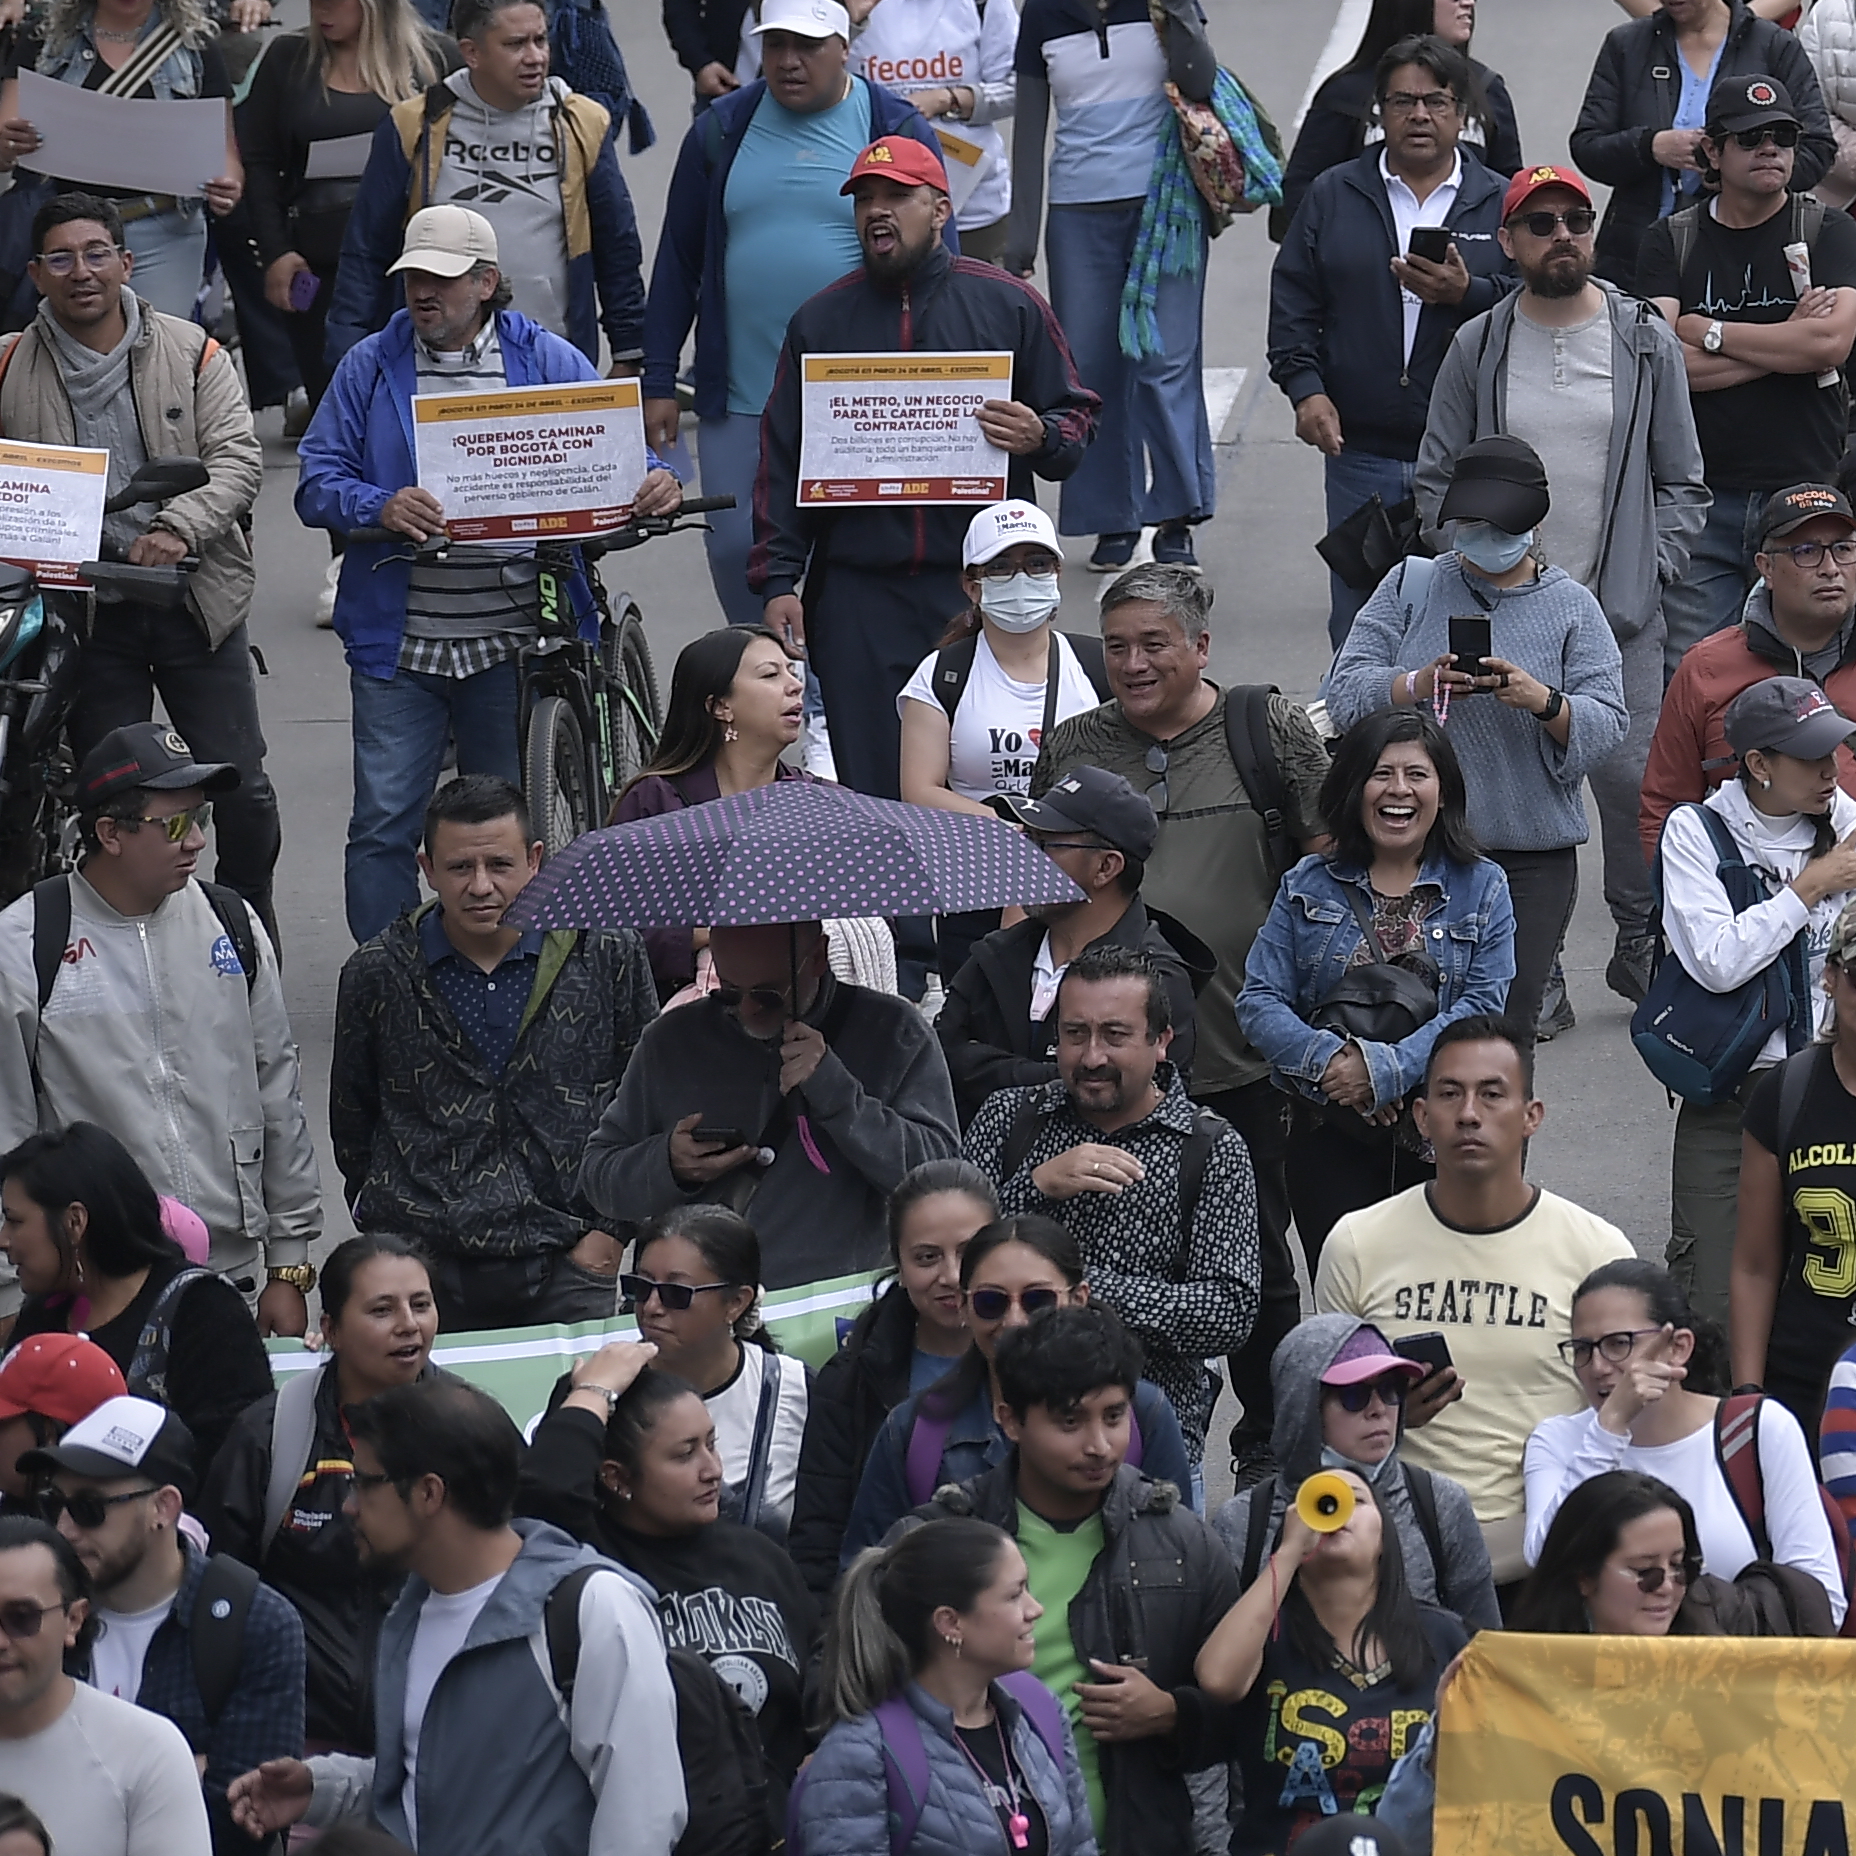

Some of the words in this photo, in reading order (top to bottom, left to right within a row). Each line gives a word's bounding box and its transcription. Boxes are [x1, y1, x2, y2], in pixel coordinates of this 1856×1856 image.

[868, 50, 963, 82] fecode
[444, 140, 556, 163] Reebo
[829, 396, 848, 409] ¡EL
[852, 396, 900, 407] METRO,
[904, 396, 923, 407] UN
[926, 395, 984, 406] NEGOCIO
[833, 409, 868, 419] PARA
[872, 409, 886, 419] EL
[890, 408, 939, 419] CARTEL
[943, 408, 960, 418] DE
[963, 408, 978, 417] LA
[854, 418, 958, 432] CONTRATACIÓN!
[452, 430, 534, 448] ¡QUEREMOS
[539, 425, 606, 439] CAMINAR
[948, 435, 960, 443] No
[963, 435, 978, 444] hay
[467, 446, 495, 457] POR
[500, 439, 558, 455] BOGOTÁ
[562, 438, 593, 450] CON
[911, 445, 952, 455] banquete
[955, 446, 974, 454] para
[493, 453, 568, 468] DIGNIDAD!
[866, 455, 873, 463] la
[446, 475, 461, 484] No
[463, 471, 483, 483] más
[485, 470, 519, 481] huecos
[521, 472, 527, 481] y
[592, 463, 617, 472] Cada
[453, 482, 500, 493] accidente
[502, 482, 514, 490] es
[516, 475, 593, 490] responsabilidad
[597, 474, 612, 482] del
[904, 483, 930, 494] ADE
[464, 492, 507, 504] perverso
[508, 488, 553, 501] gobierno
[555, 487, 568, 496] de
[570, 484, 602, 495] Galán.
[951, 487, 990, 495] Palestina!
[539, 517, 568, 529] ADE
[994, 513, 1008, 524] Yo
[988, 728, 1022, 754] Yo
[1395, 1277, 1551, 1331] SEATTLE
